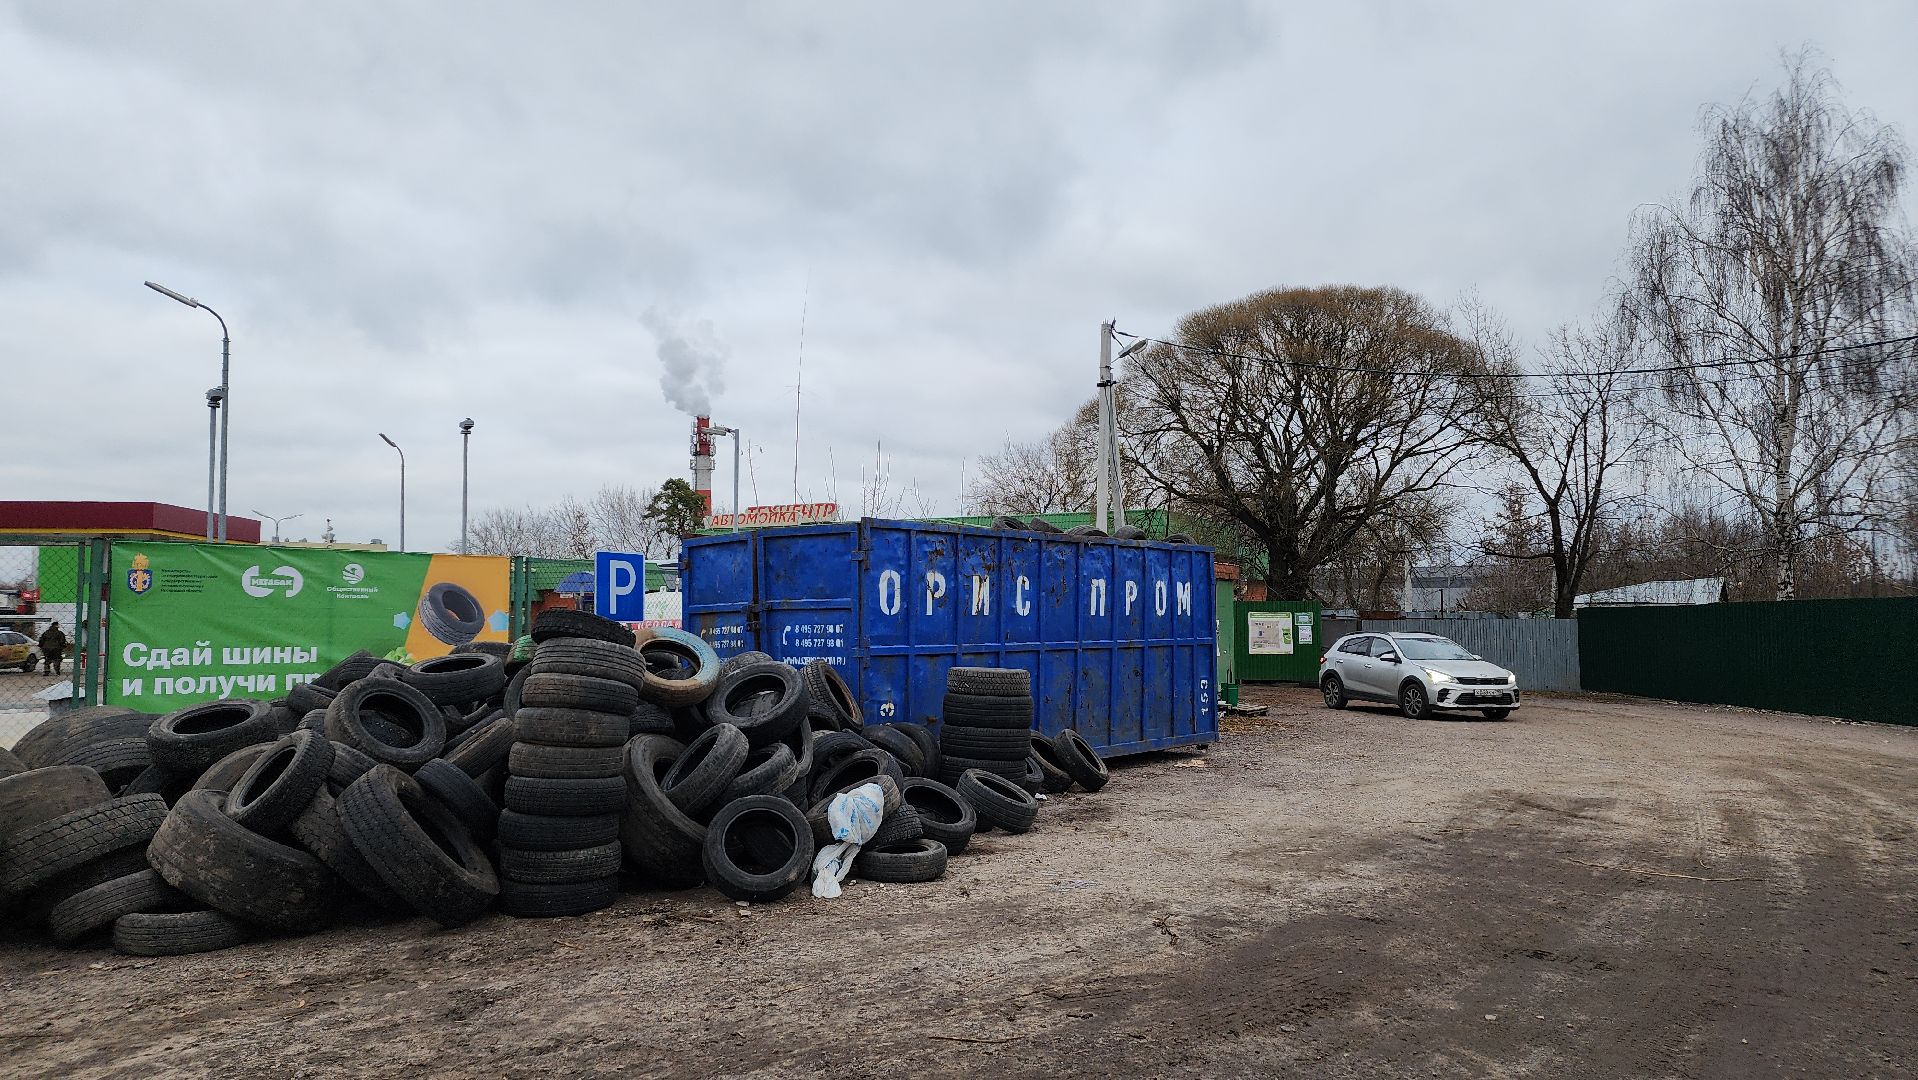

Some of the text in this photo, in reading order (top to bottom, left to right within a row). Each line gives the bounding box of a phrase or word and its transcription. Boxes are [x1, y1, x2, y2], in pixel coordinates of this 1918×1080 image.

[609, 559, 637, 615] P
[878, 569, 1191, 617] ОРИС ПРОМ
[795, 625, 800, 633] 8
[800, 625, 812, 633] 495
[813, 625, 824, 633] 727
[795, 639, 800, 647] 8
[800, 639, 812, 647] 495
[813, 639, 824, 647] 727
[123, 640, 318, 671] Сдай шины
[122, 678, 143, 696] и
[153, 674, 276, 700] получи
